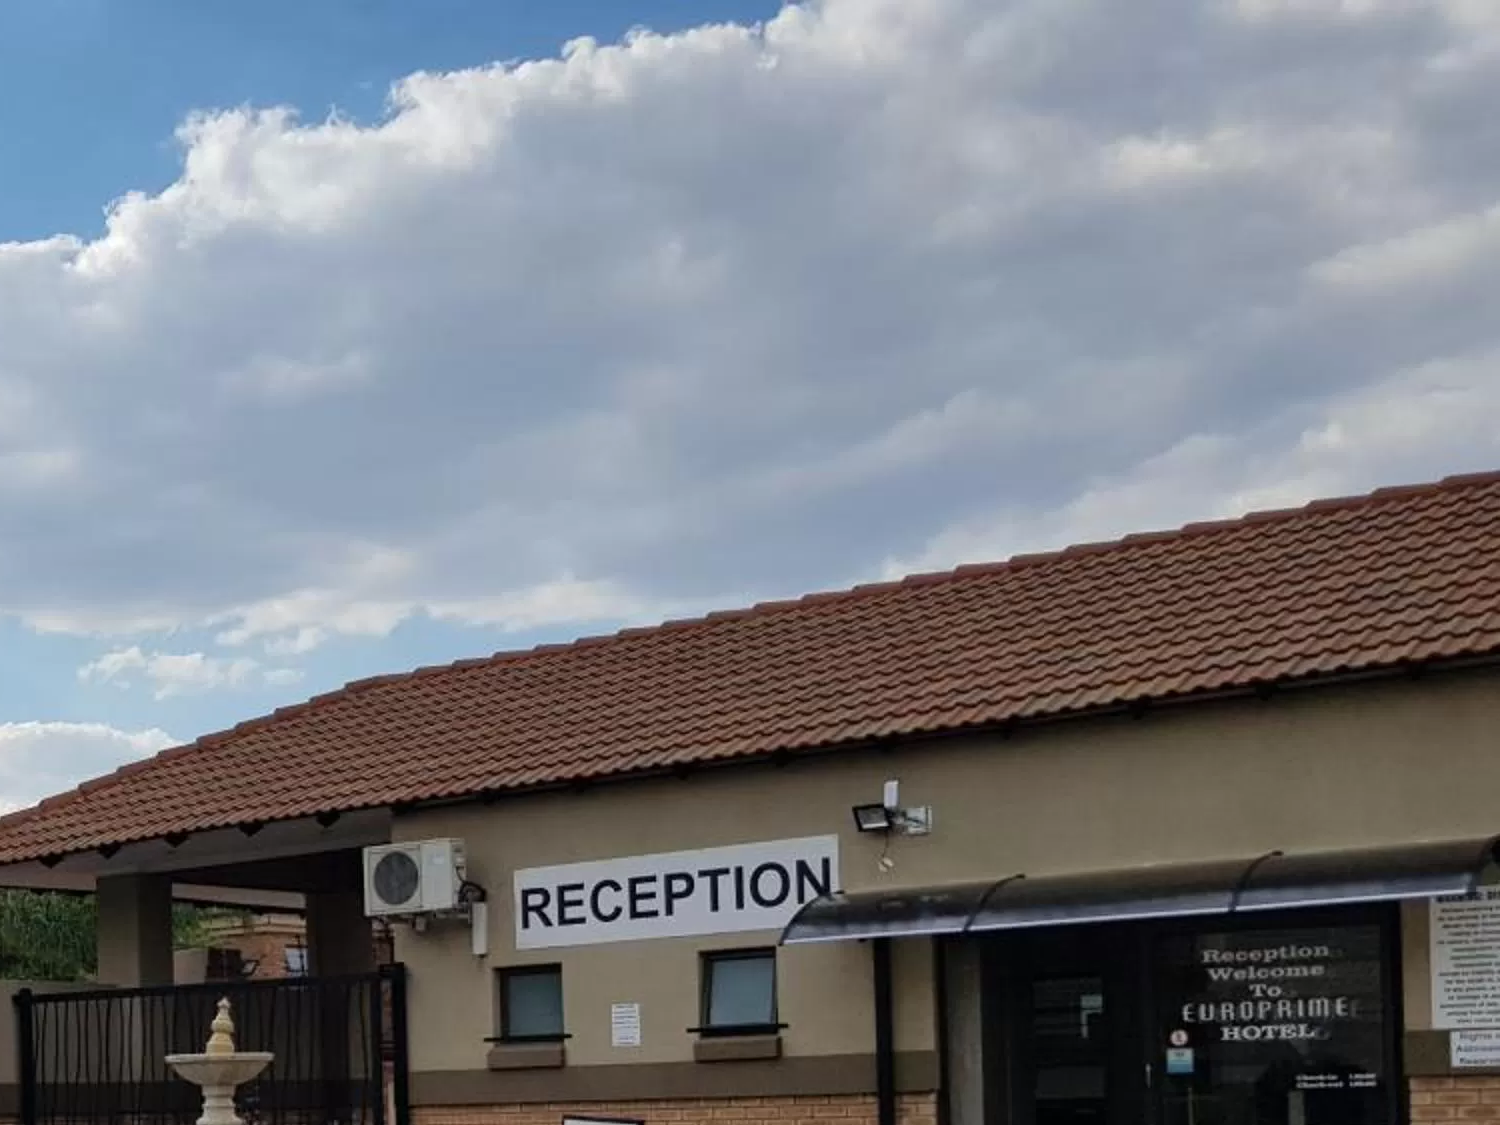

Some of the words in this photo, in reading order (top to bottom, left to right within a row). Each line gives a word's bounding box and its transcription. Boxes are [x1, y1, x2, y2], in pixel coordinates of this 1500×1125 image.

[520, 857, 830, 929] RECEPTION
[1202, 945, 1329, 964] Reception
[1207, 964, 1325, 981] Welcome
[1249, 983, 1281, 997] To
[1182, 996, 1348, 1023] EUROPRIME
[1220, 1023, 1315, 1041] HOTEL
